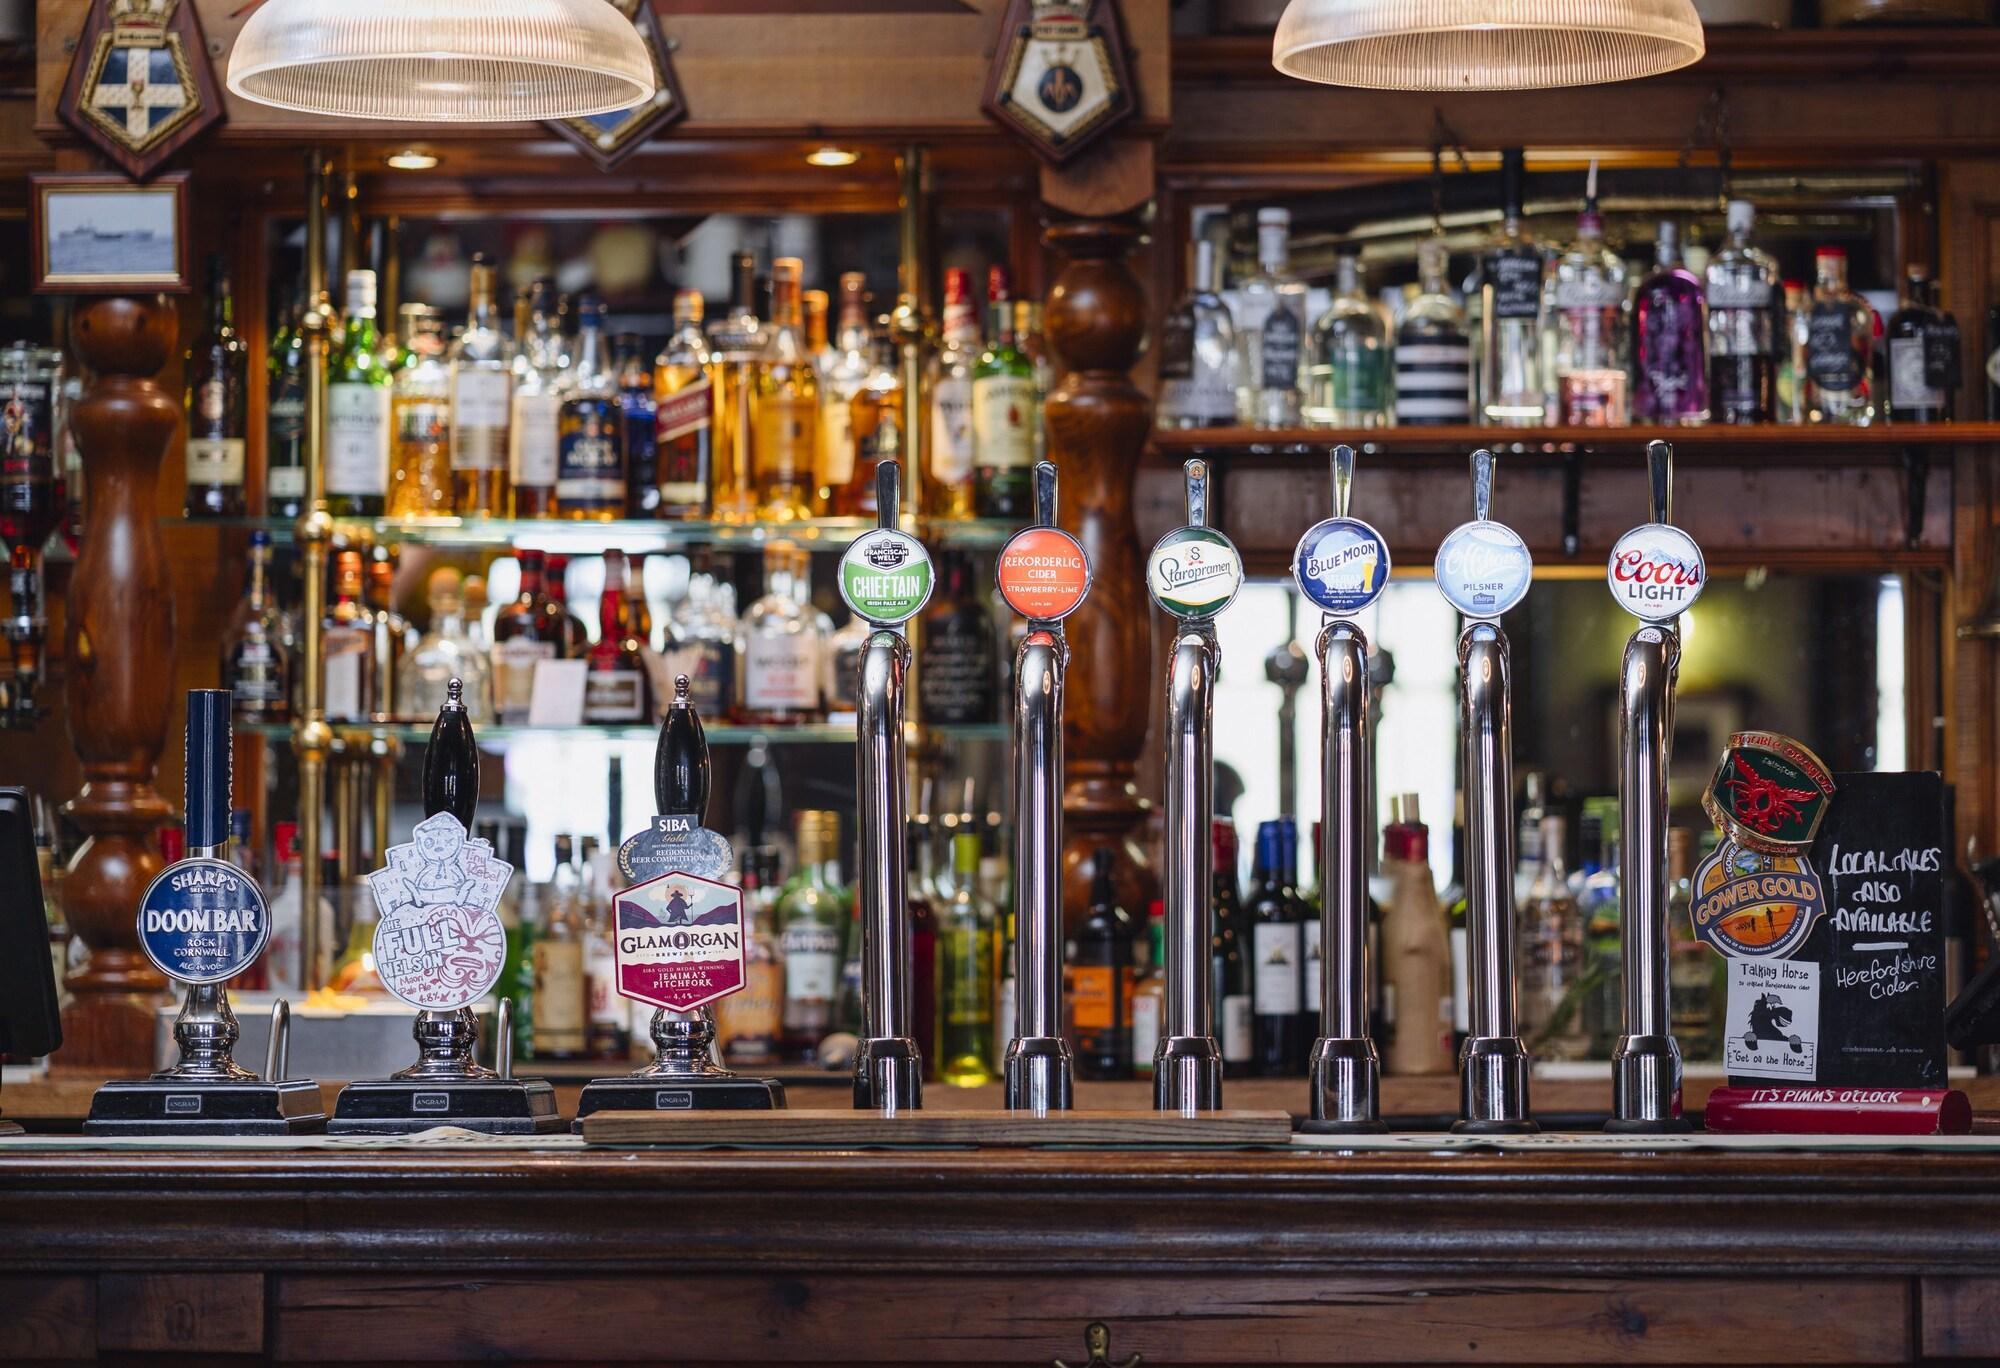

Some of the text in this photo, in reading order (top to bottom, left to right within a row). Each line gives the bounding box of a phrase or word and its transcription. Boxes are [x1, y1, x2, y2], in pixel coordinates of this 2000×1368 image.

[1004, 556, 1080, 568] REKORDERLIG
[1308, 543, 1375, 577] BLUE MOON
[1615, 549, 1699, 585] Coors
[1028, 569, 1056, 578] CIDER
[1159, 557, 1232, 591] Staropramen
[853, 575, 920, 598] CHIEFTAIN
[1006, 585, 1078, 593] STRAWBERRY-LIME
[1463, 583, 1504, 591] PILSNER
[1629, 584, 1685, 600] LIGHT
[659, 819, 690, 832] SIBA
[661, 833, 688, 843] Gold
[464, 848, 487, 868] Tiny
[631, 856, 651, 864] BEER
[651, 855, 705, 863] COMPETITION
[656, 849, 694, 857] REGIONAL
[1725, 843, 1741, 873] GOWER
[1828, 843, 1942, 875] LOCAL ALES
[467, 861, 501, 882] Rebel
[171, 871, 239, 892] SHARP'S
[1696, 877, 1817, 925] GOWER GOLD
[146, 909, 259, 933] DOOM BAR
[382, 918, 401, 932] THE
[1829, 907, 1932, 932] AVAILABLE
[186, 938, 216, 948] ROCK
[382, 919, 461, 961] FULL
[620, 931, 739, 954] GLAMORGAN
[1771, 935, 1791, 950] NATURAL
[174, 947, 230, 958] CORNWALL
[382, 951, 444, 978] NELSON
[1740, 962, 1809, 980] Talking Horse
[1836, 953, 1937, 988] Herefordshire
[653, 978, 713, 989] PITCHFORK
[659, 971, 706, 981] JEMIMA'S
[400, 982, 432, 997] Pale Ale
[1765, 980, 1797, 990] Herefordshire
[418, 991, 440, 1003] 4.8%
[673, 992, 693, 1000] 4.4%
[1753, 1055, 1762, 1063] on
[1766, 1055, 1779, 1065] the
[1751, 1089, 1903, 1104] IT'S PIMM'S O'CLOCK
